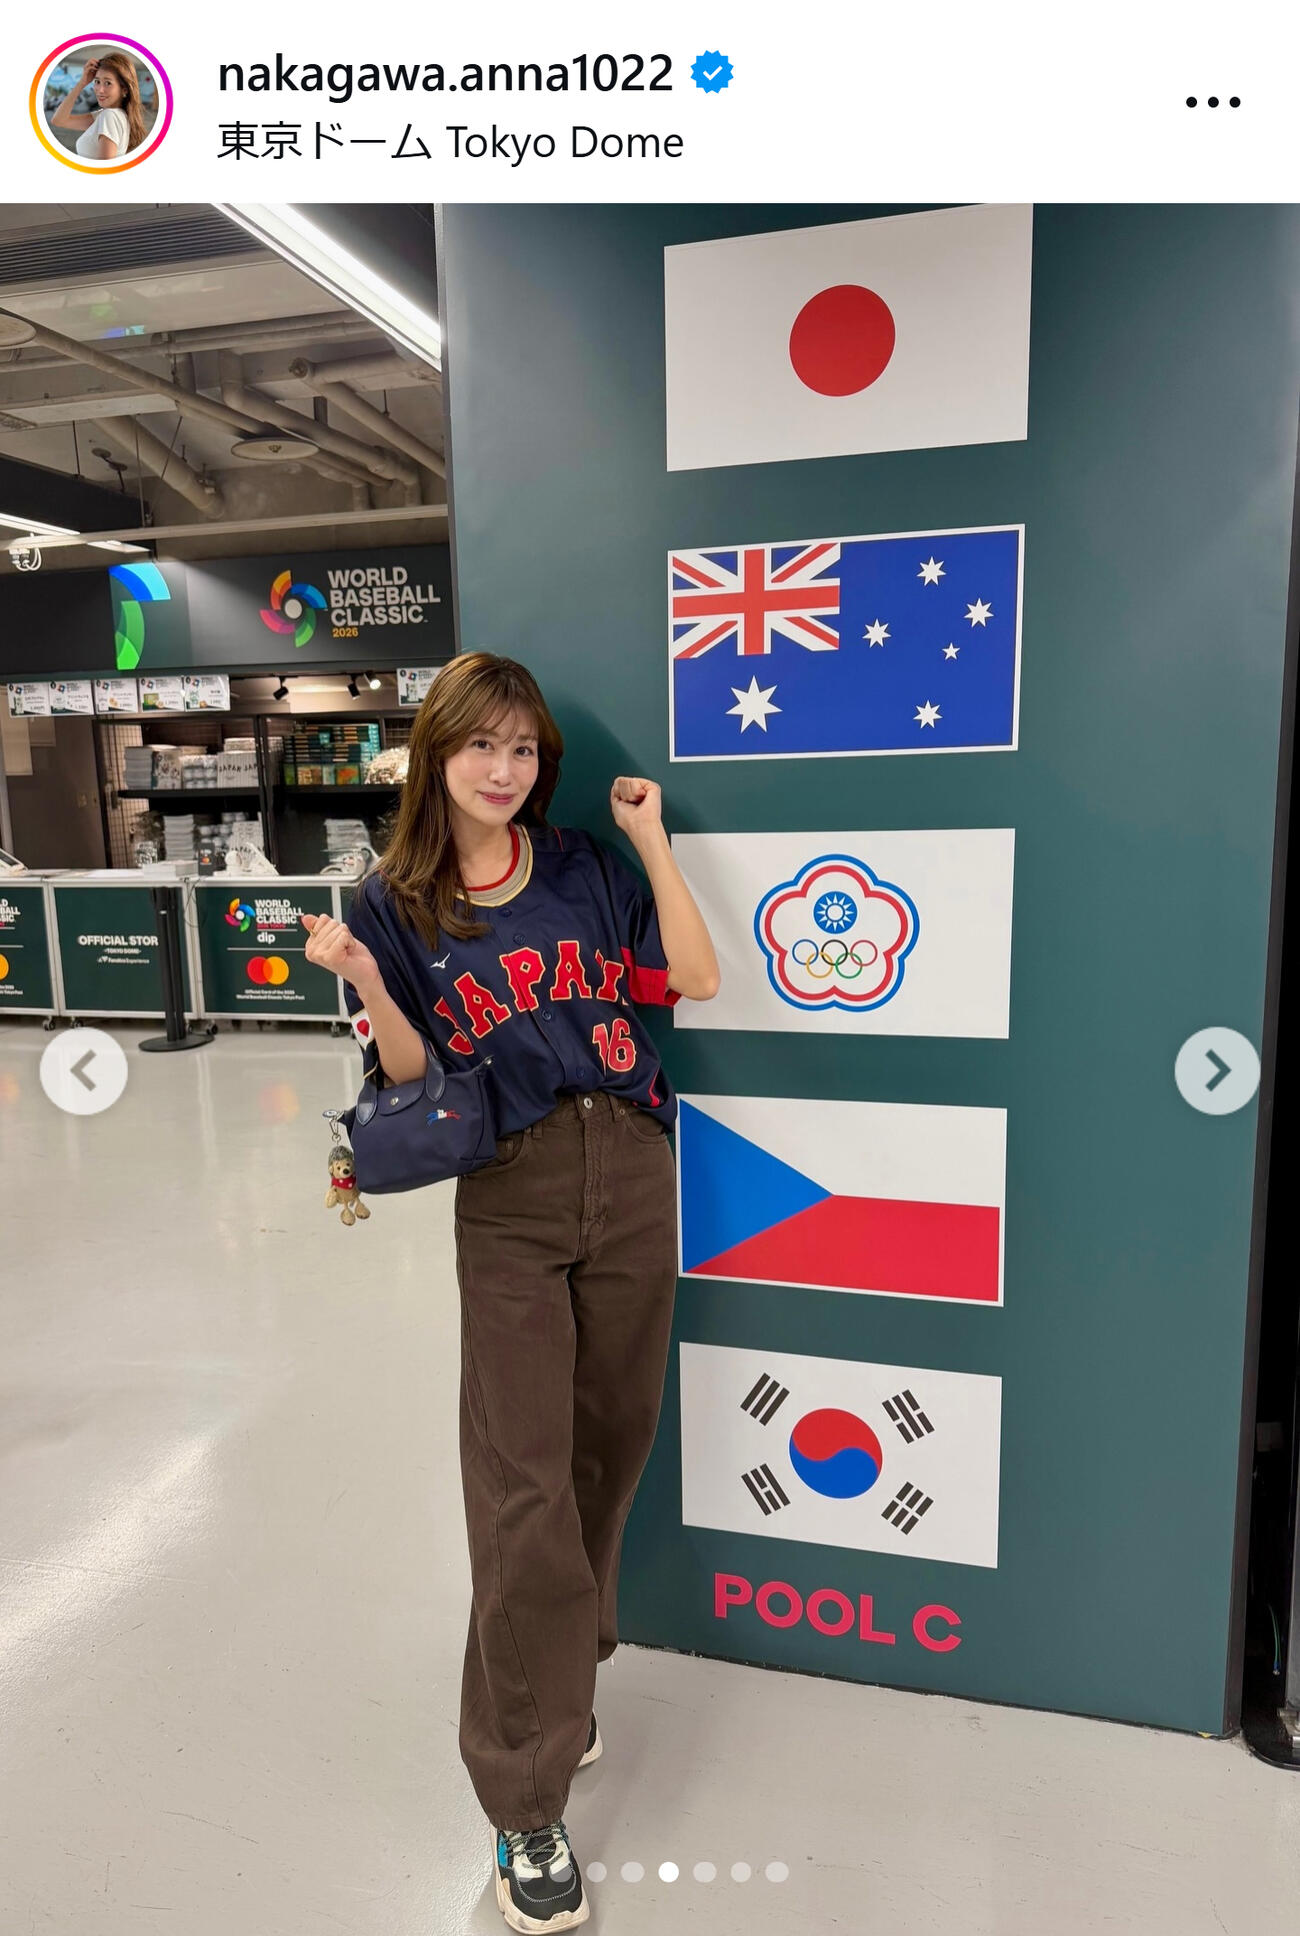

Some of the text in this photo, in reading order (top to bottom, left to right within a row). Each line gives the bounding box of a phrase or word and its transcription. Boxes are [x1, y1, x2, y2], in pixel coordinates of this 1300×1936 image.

[328, 566, 408, 589] WORLD
[330, 584, 441, 608] BASEBALL
[331, 604, 424, 627] CLASSIC
[332, 627, 359, 638] 2026
[254, 899, 291, 908] WORLD
[255, 907, 304, 917] BASEBALL
[256, 915, 298, 924] CLASSIC
[78, 934, 159, 946] OFFICIAL STOR
[257, 931, 276, 945] dip
[592, 1018, 637, 1077] 16
[714, 1571, 962, 1652] POOL C
